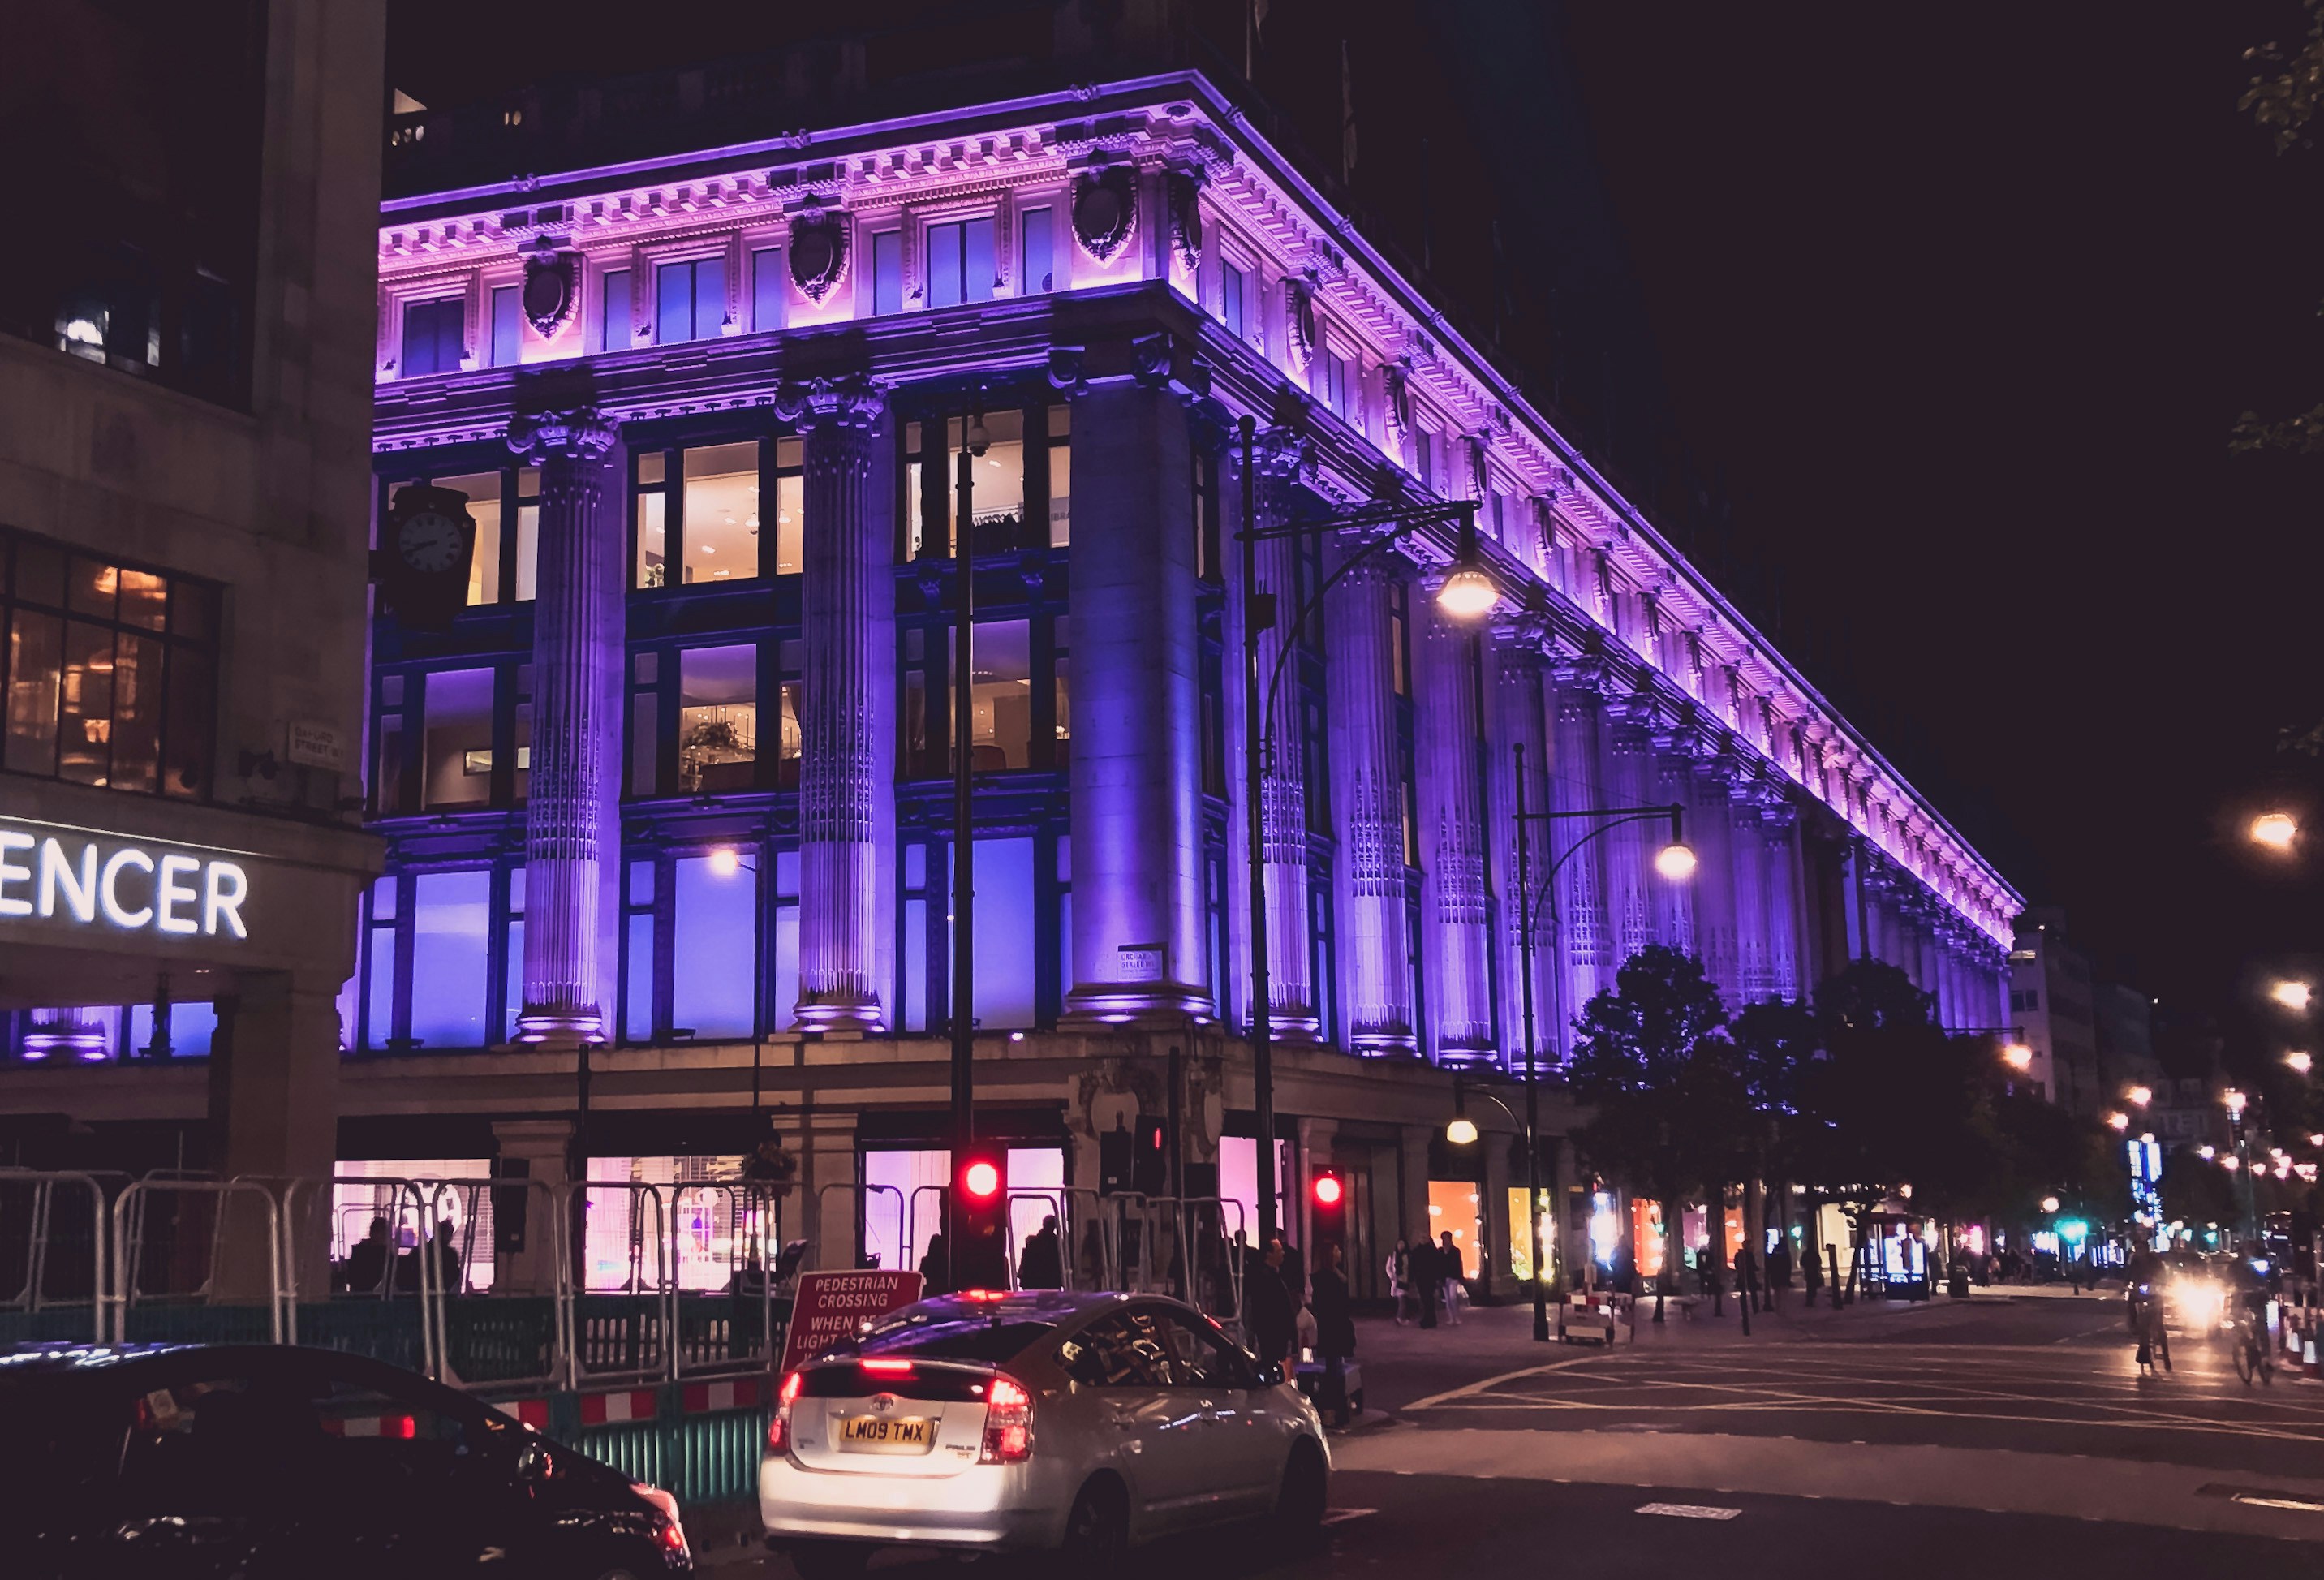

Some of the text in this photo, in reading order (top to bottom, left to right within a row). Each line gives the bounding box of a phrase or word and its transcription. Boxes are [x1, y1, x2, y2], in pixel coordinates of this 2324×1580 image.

[0, 830, 247, 938] ENCER
[815, 1276, 899, 1292] PEDESTRIAN
[817, 1293, 889, 1308] CROSSING
[811, 1315, 854, 1331] WHEN
[796, 1334, 838, 1350] LIGHT
[845, 1421, 924, 1441] LM09 TMX
